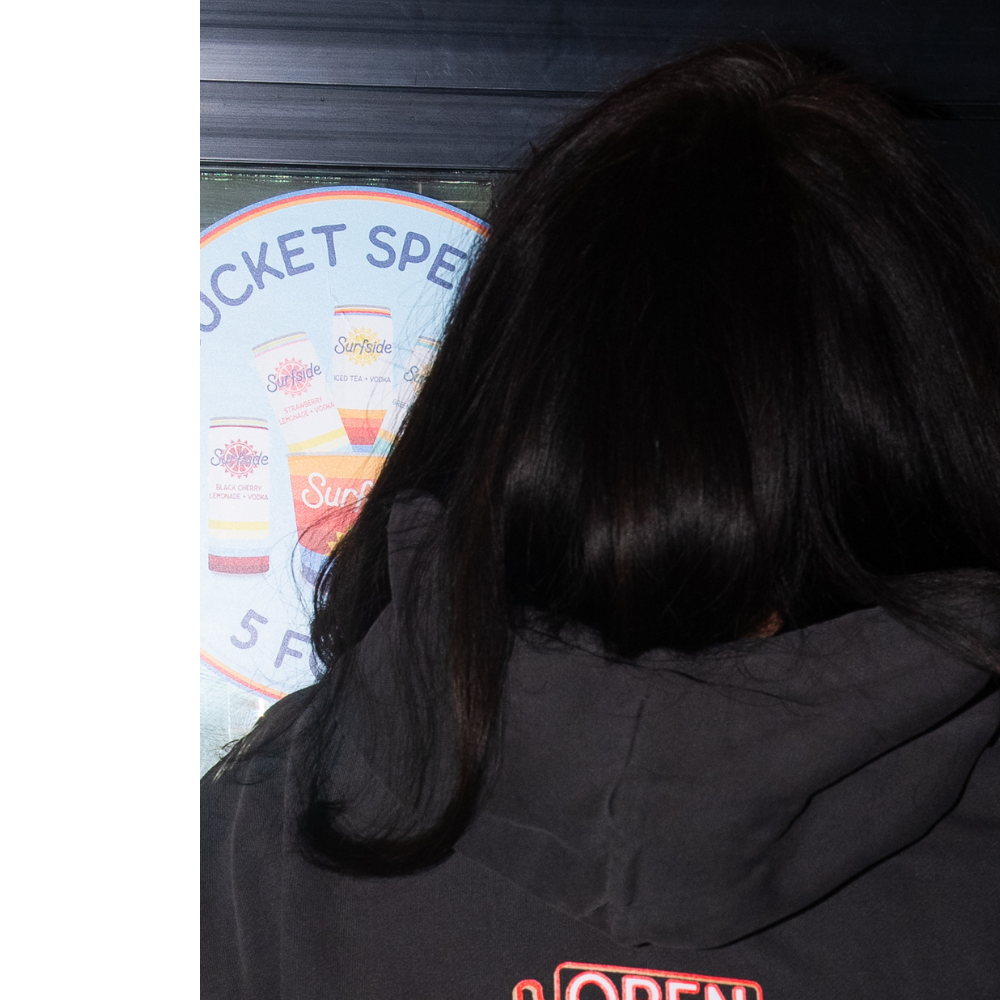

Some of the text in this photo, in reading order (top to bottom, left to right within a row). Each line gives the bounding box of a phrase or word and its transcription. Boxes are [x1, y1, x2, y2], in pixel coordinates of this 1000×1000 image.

[333, 335, 393, 355] Surfside
[266, 362, 323, 393] Surfside
[333, 374, 349, 382] ICED
[369, 375, 392, 383] VODKA
[278, 410, 311, 426] LEMONADE
[314, 401, 336, 414] VODKA
[283, 396, 323, 415] STRAWBERRY
[210, 448, 269, 467] Surfside
[215, 483, 262, 492] BLACK CHERRY
[229, 608, 269, 650] 5
